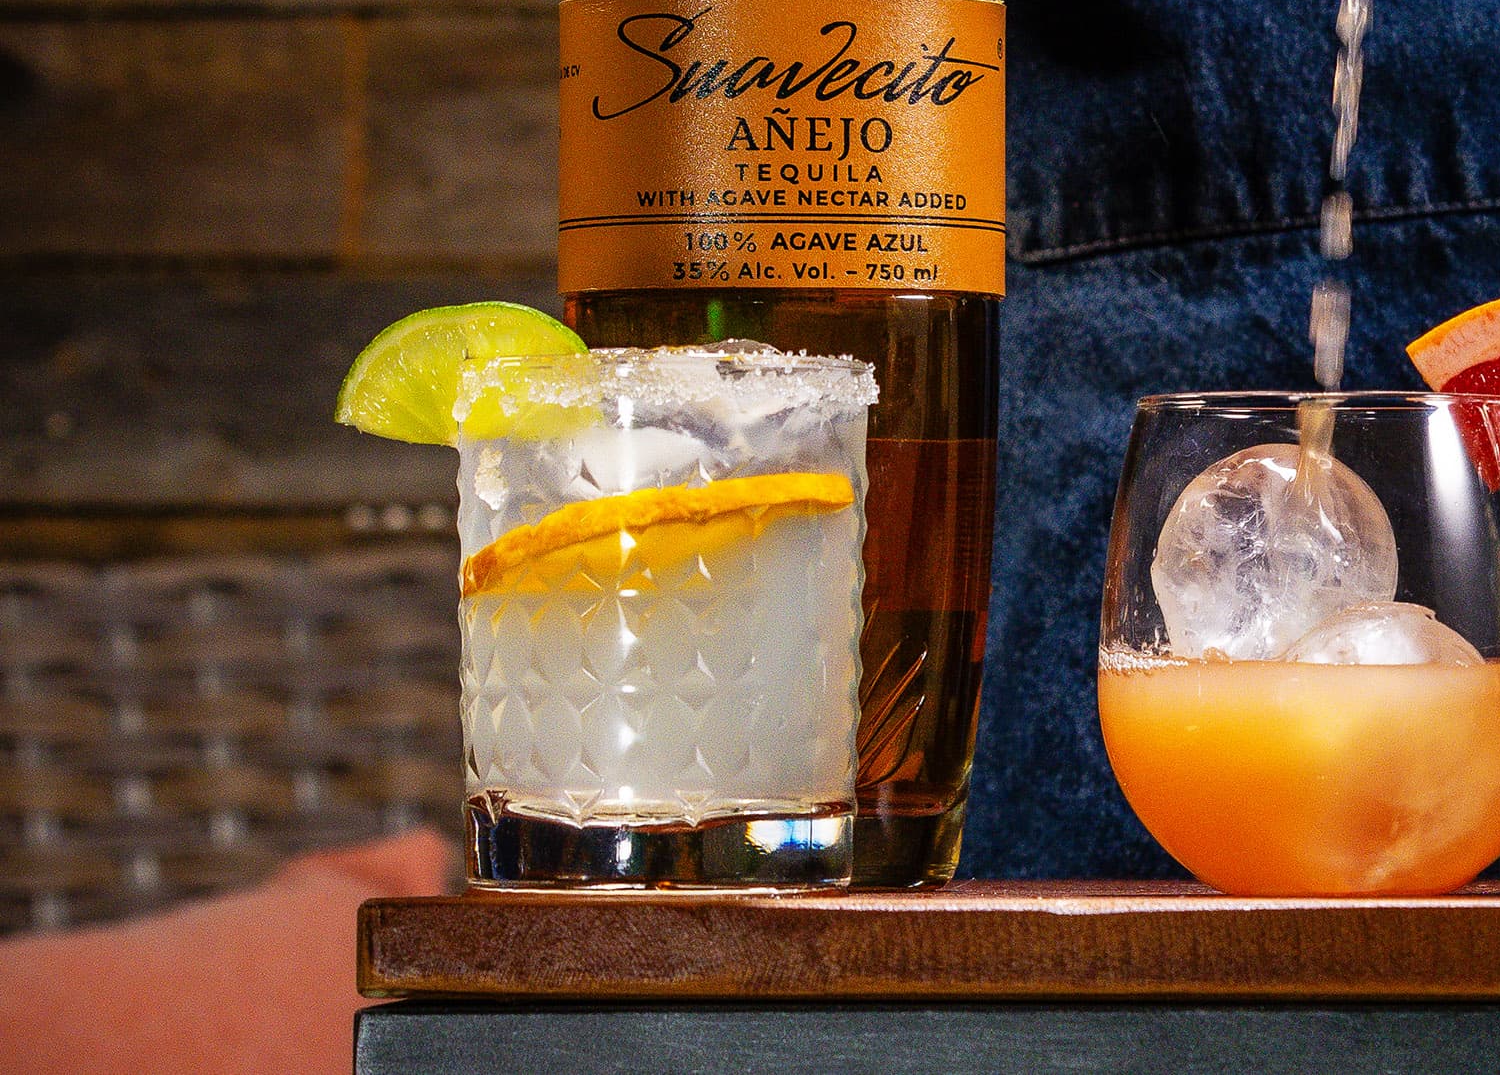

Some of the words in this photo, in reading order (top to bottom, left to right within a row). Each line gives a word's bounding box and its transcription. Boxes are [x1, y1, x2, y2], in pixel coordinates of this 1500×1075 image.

[592, 7, 999, 120] Suavecito
[727, 107, 893, 161] AÑEJO
[734, 163, 883, 185] TEQUILA
[637, 190, 695, 208] WITH
[707, 189, 786, 207] AGAVE
[798, 189, 889, 208] NECTAR
[898, 191, 967, 211] ADDED
[684, 231, 757, 252] 100%
[770, 232, 857, 251] AGAVE
[866, 233, 928, 254] AZUL
[672, 261, 729, 281] 35%
[738, 262, 782, 280] Alc.
[792, 262, 836, 280] Vol.
[866, 263, 905, 281] 750
[913, 264, 938, 281] ml
